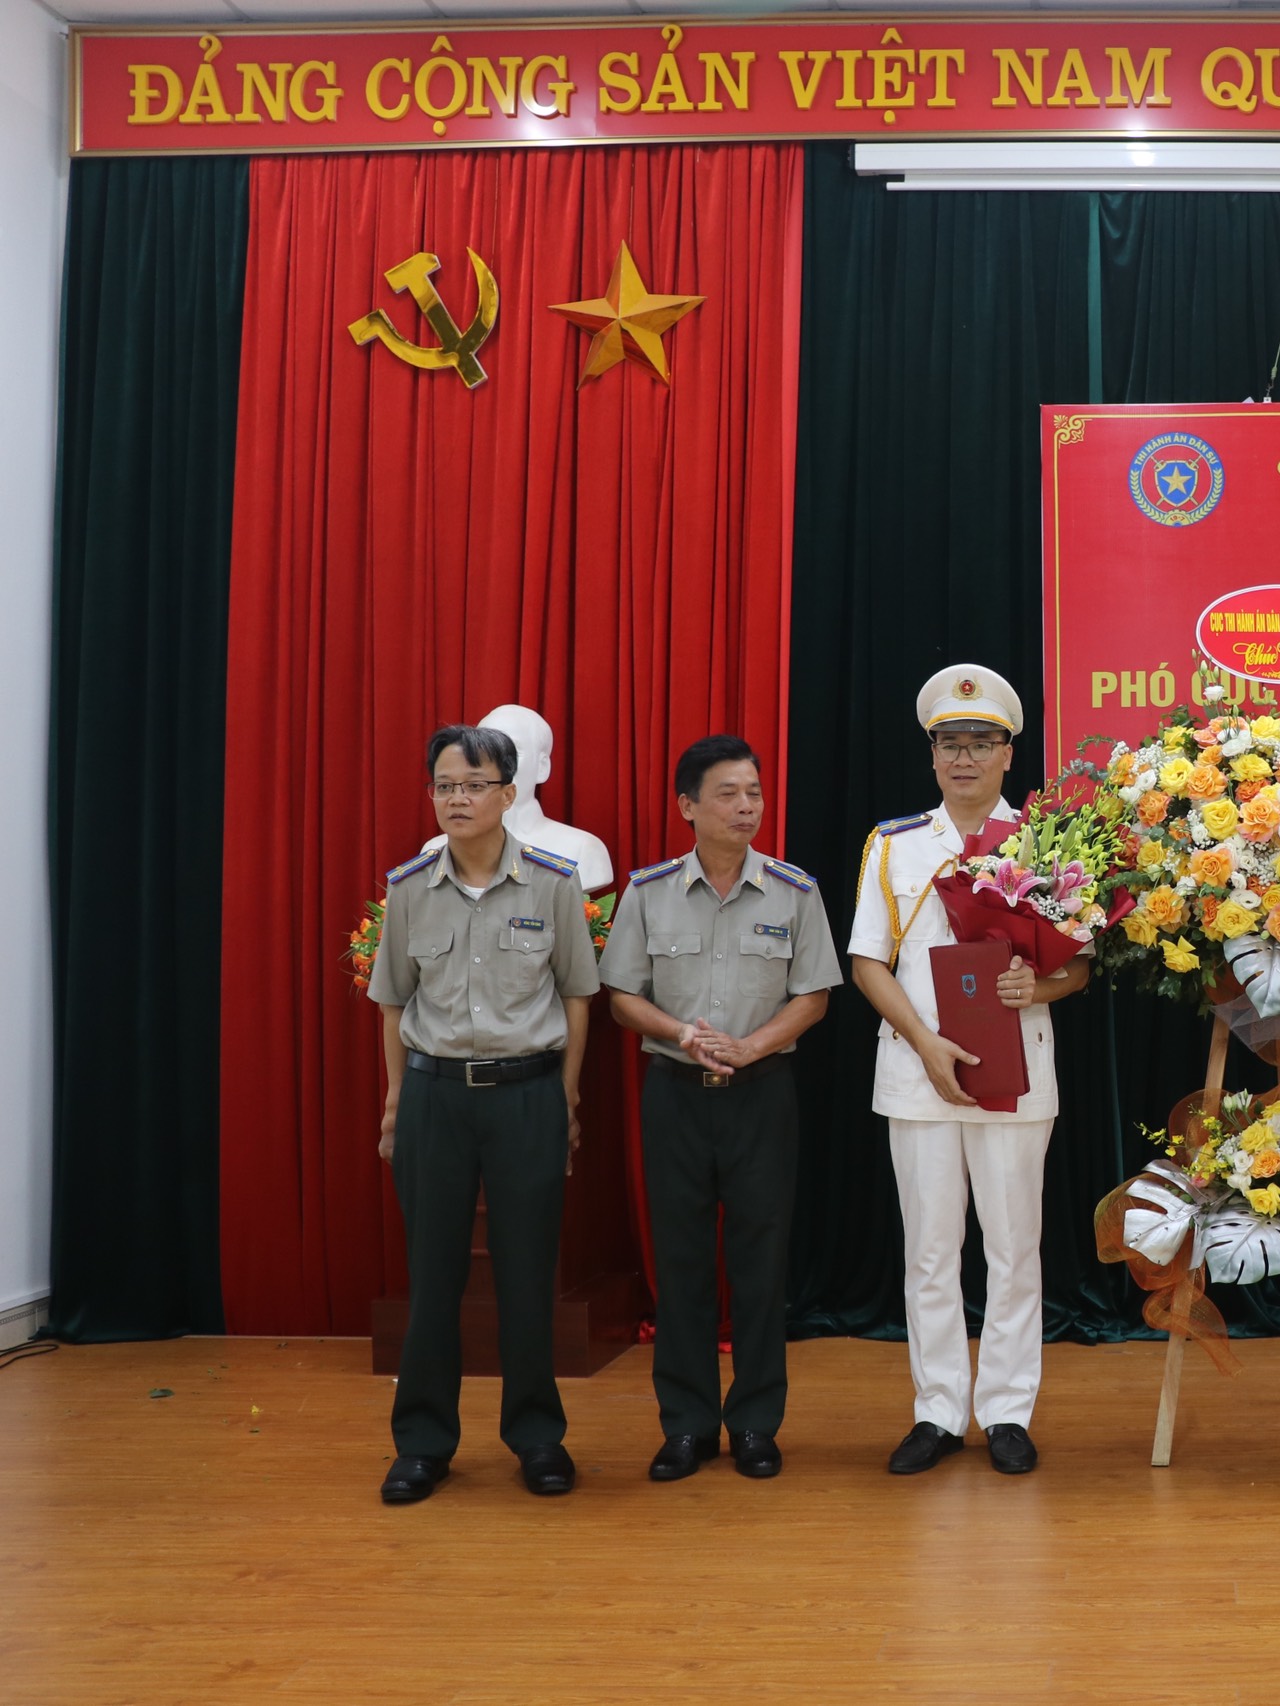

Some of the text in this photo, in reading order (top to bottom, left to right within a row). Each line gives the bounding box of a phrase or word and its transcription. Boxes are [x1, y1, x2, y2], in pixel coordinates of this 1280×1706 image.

[127, 33, 345, 125] ĐẢNG
[365, 35, 575, 136] CỘNG
[599, 23, 756, 114] SẢN
[779, 27, 965, 124] VIỆT
[992, 47, 1173, 108] NAM
[1134, 432, 1218, 466] THI HÀNH ÁN DÂN SỰ
[1233, 641, 1278, 674] Chúc
[1091, 661, 1176, 708] PHÓ
